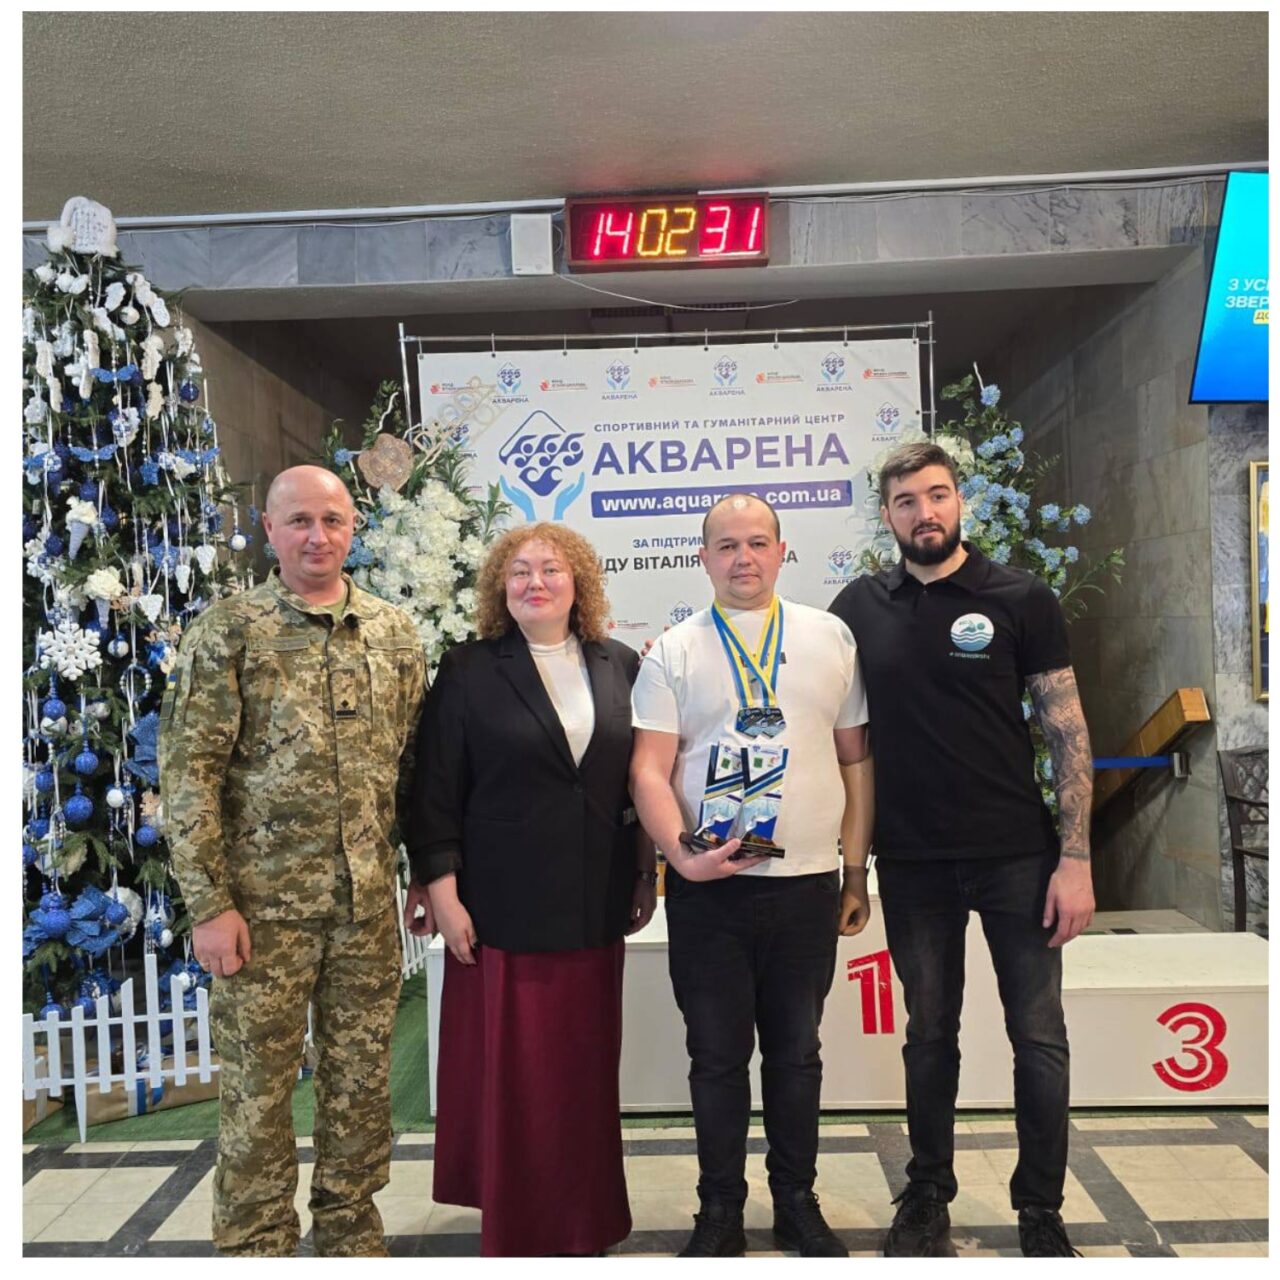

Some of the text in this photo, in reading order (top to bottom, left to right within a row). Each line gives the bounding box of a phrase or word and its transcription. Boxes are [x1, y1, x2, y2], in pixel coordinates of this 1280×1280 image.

[593, 206, 760, 256] 14 02 31
[1228, 278, 1239, 291] З
[594, 414, 845, 433] СПОРТИВНИЙ ТА ГУМАНІТАРНИЙ ЦЕНТР
[591, 432, 850, 476] АКВАРЕНА
[601, 486, 842, 514] www.aquar.com.ua
[633, 539, 650, 549] ЗА
[633, 554, 701, 570] ВІТАЛІЯ
[847, 949, 895, 1035] 1
[1152, 1002, 1229, 1092] 3
